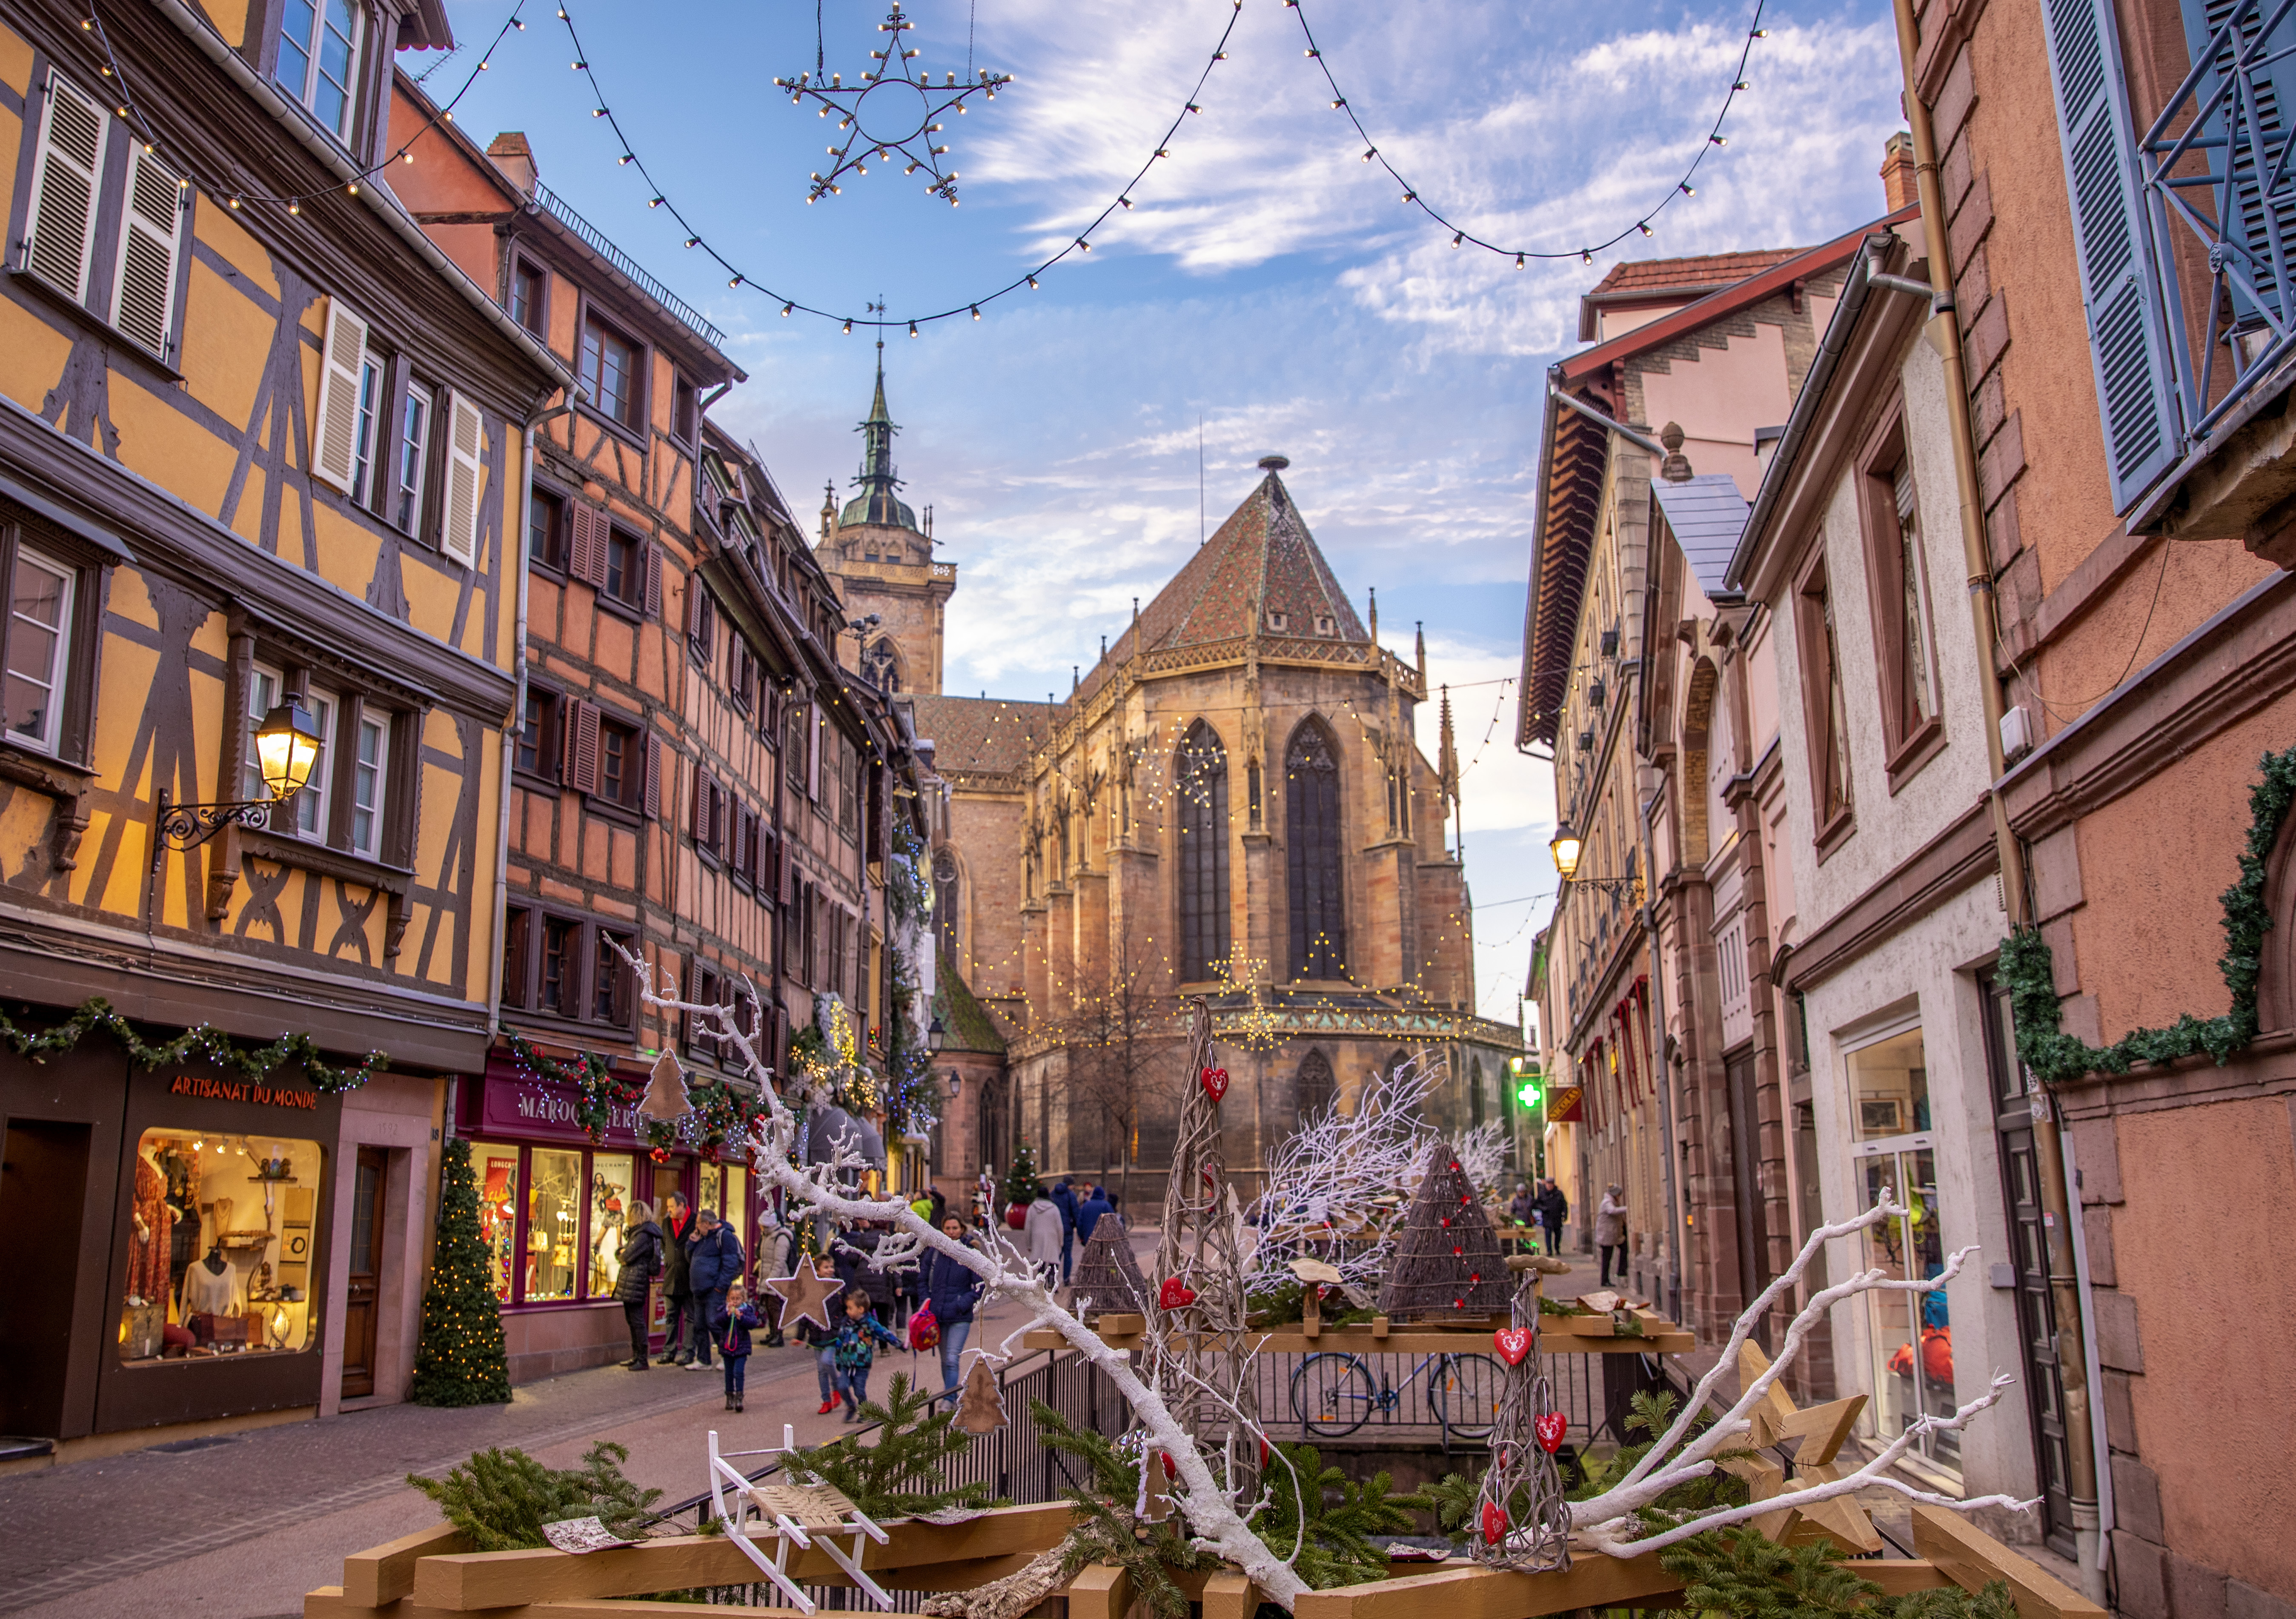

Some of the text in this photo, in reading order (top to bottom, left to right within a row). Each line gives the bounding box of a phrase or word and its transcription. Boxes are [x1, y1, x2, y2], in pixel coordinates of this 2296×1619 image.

[172, 1076, 318, 1110] ARTISANAT DU MONDE
[520, 1096, 645, 1130] MAROQERIE
[431, 1128, 439, 1141] 18
